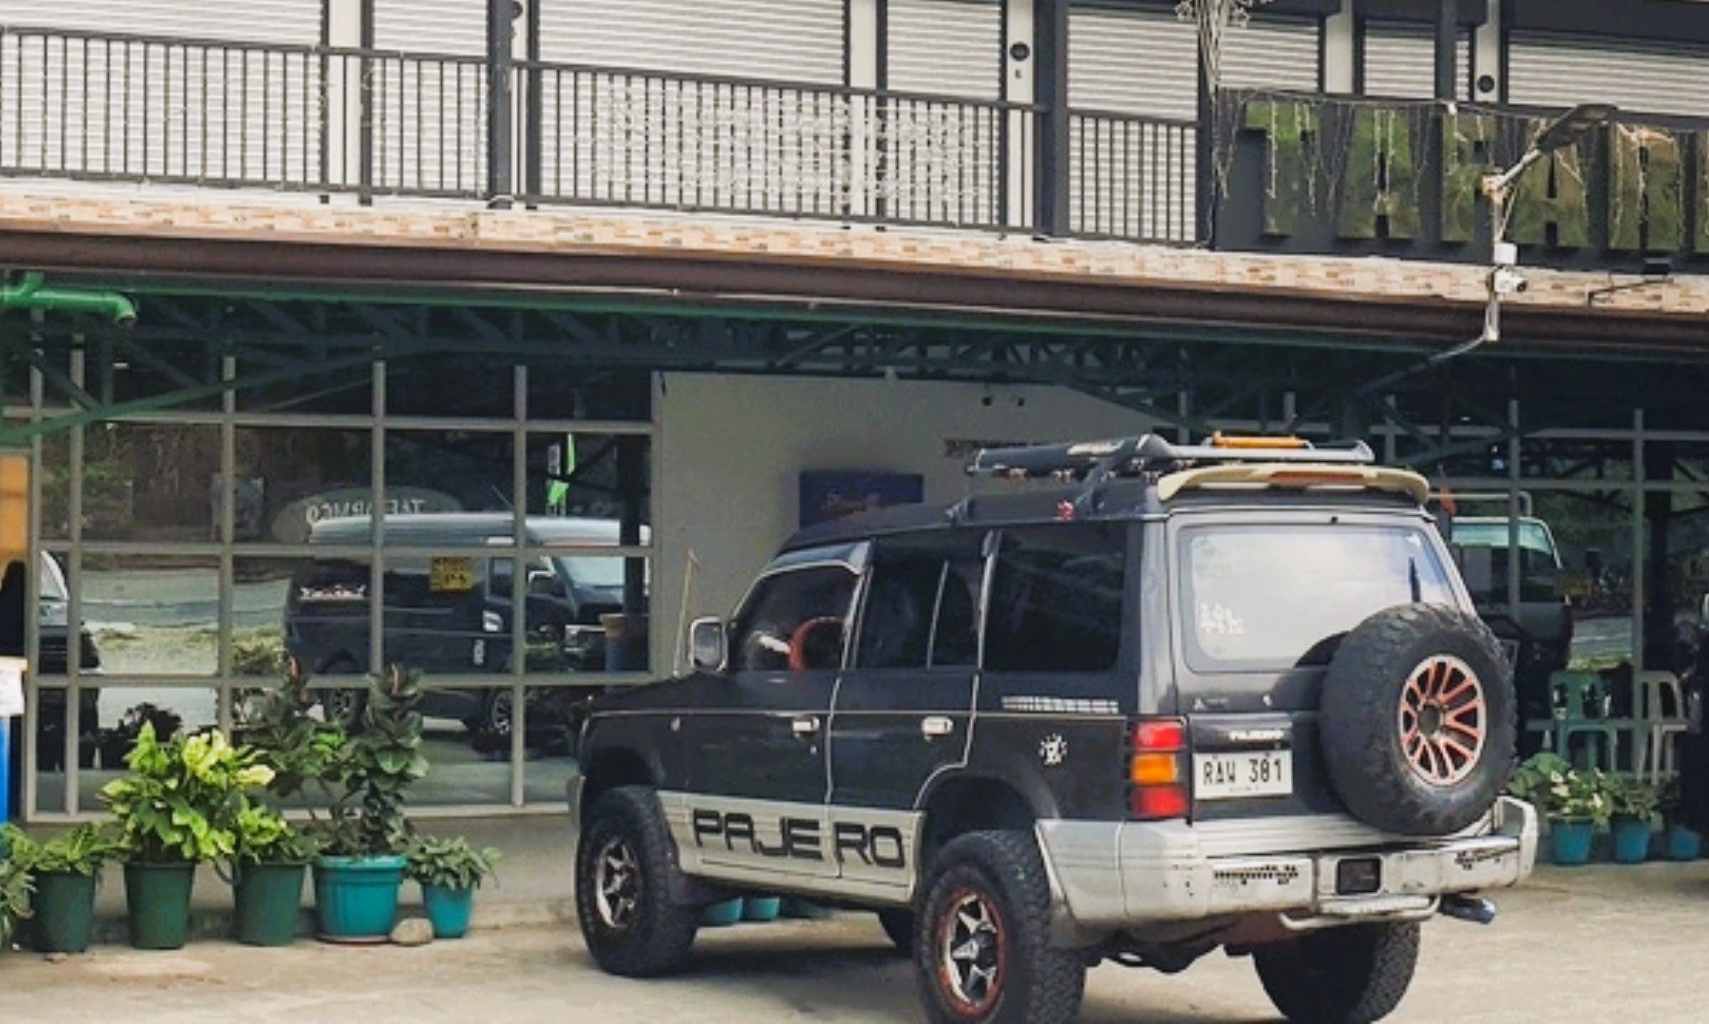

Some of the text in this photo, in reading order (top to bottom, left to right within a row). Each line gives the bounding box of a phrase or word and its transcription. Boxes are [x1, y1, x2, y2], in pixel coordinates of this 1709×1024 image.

[1203, 758, 1283, 786] RAW 381
[692, 808, 906, 869] PAJERO
